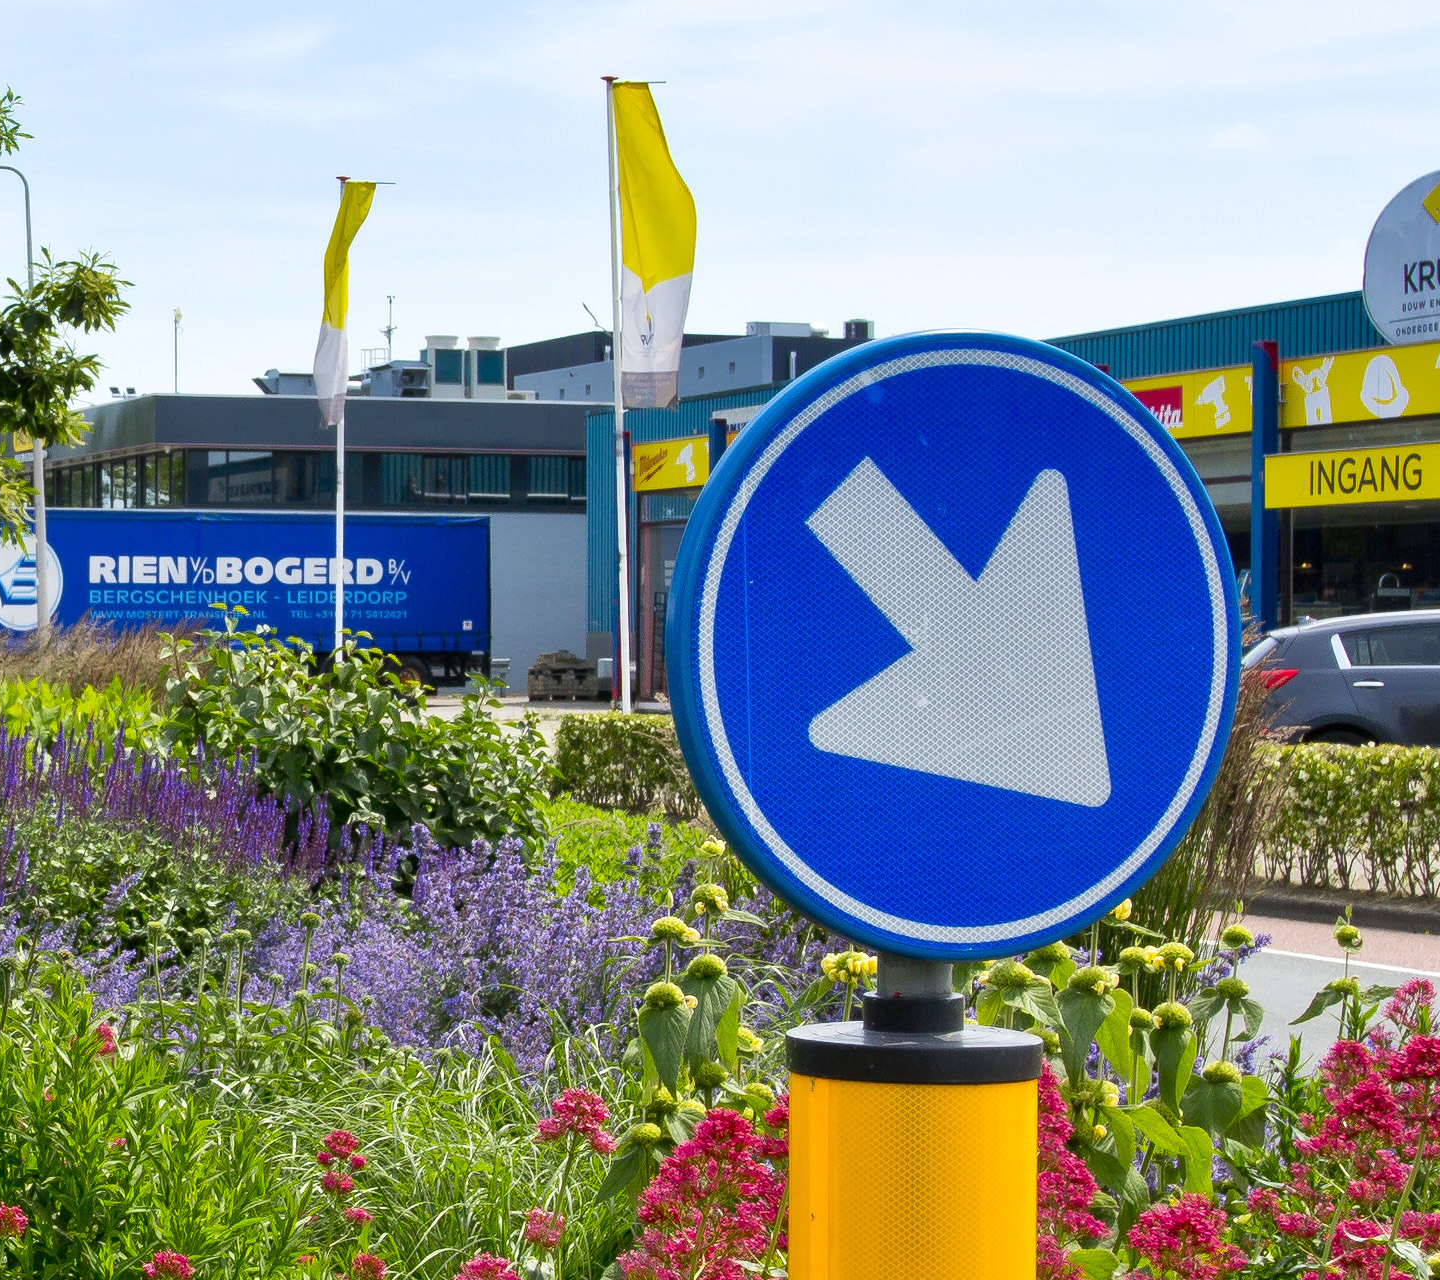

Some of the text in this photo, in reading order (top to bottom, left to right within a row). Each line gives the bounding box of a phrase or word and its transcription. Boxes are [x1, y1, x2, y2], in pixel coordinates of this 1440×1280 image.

[1402, 300, 1427, 313] BOUW
[1310, 453, 1422, 496] INGANG
[89, 555, 188, 584] RIEN
[216, 556, 384, 585] BOGERD
[89, 589, 268, 605] BERGSCHENHOEK
[287, 590, 407, 605] LEIDERDORP
